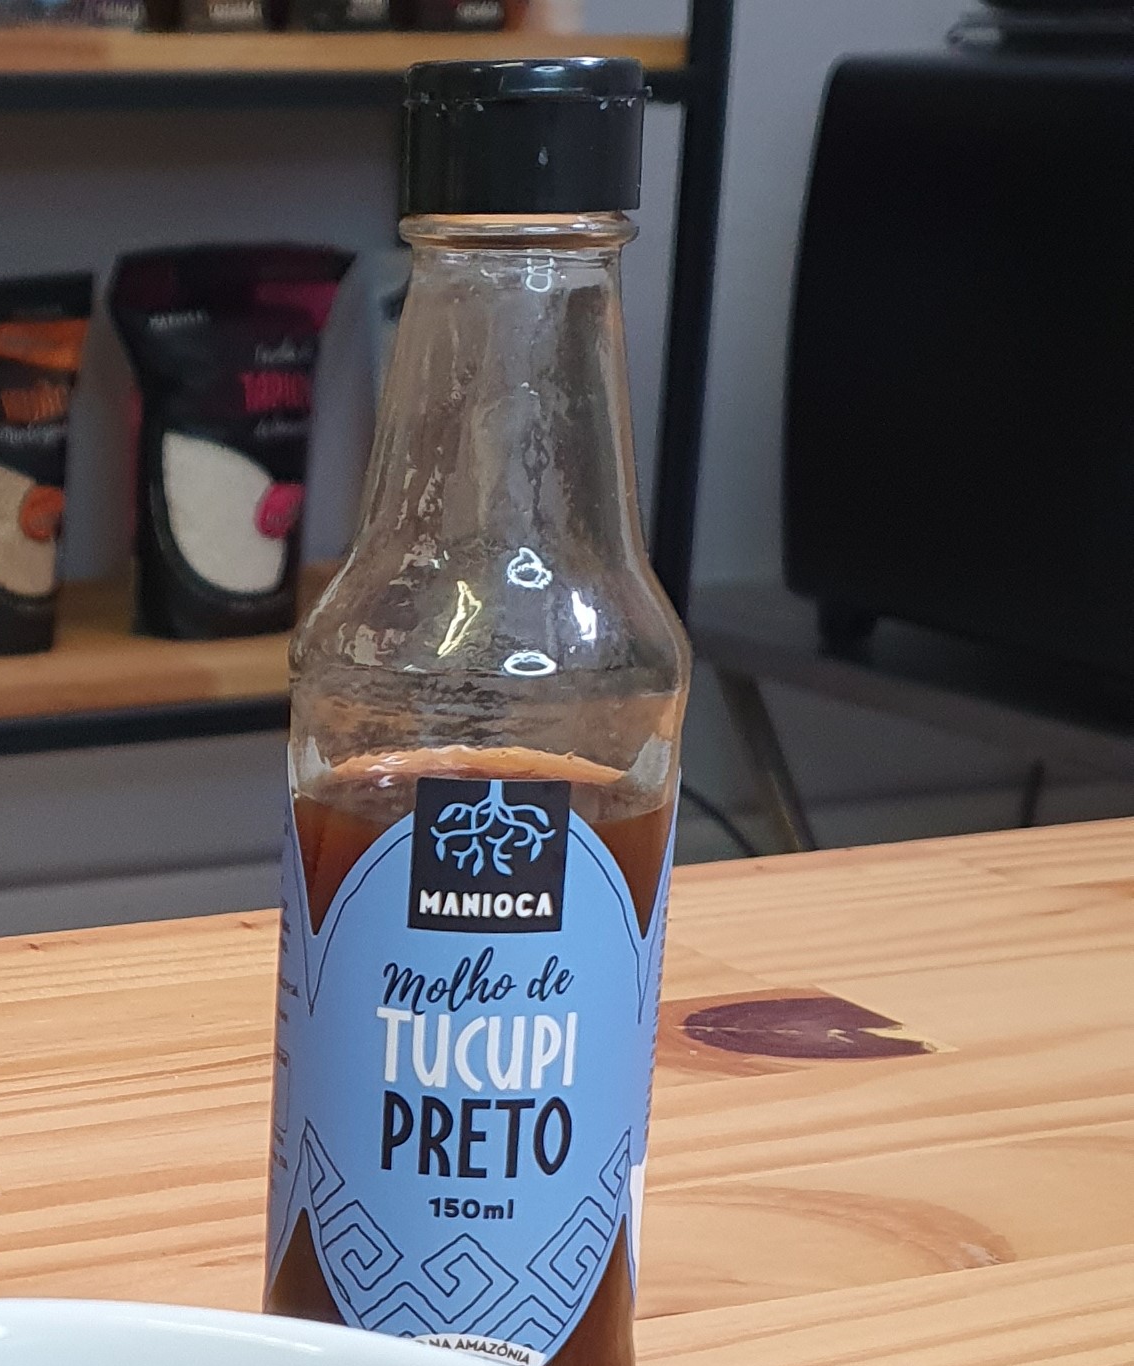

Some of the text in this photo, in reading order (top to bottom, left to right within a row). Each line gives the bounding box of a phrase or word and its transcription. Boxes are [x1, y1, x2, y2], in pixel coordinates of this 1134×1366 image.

[418, 889, 554, 918] MANIOCA
[382, 946, 575, 1015] Molho de
[376, 1006, 578, 1092] TUCUPI
[380, 1090, 573, 1179] PRETO
[428, 1196, 515, 1220] 150ml
[454, 1338, 530, 1365] AMAZÔNIA
